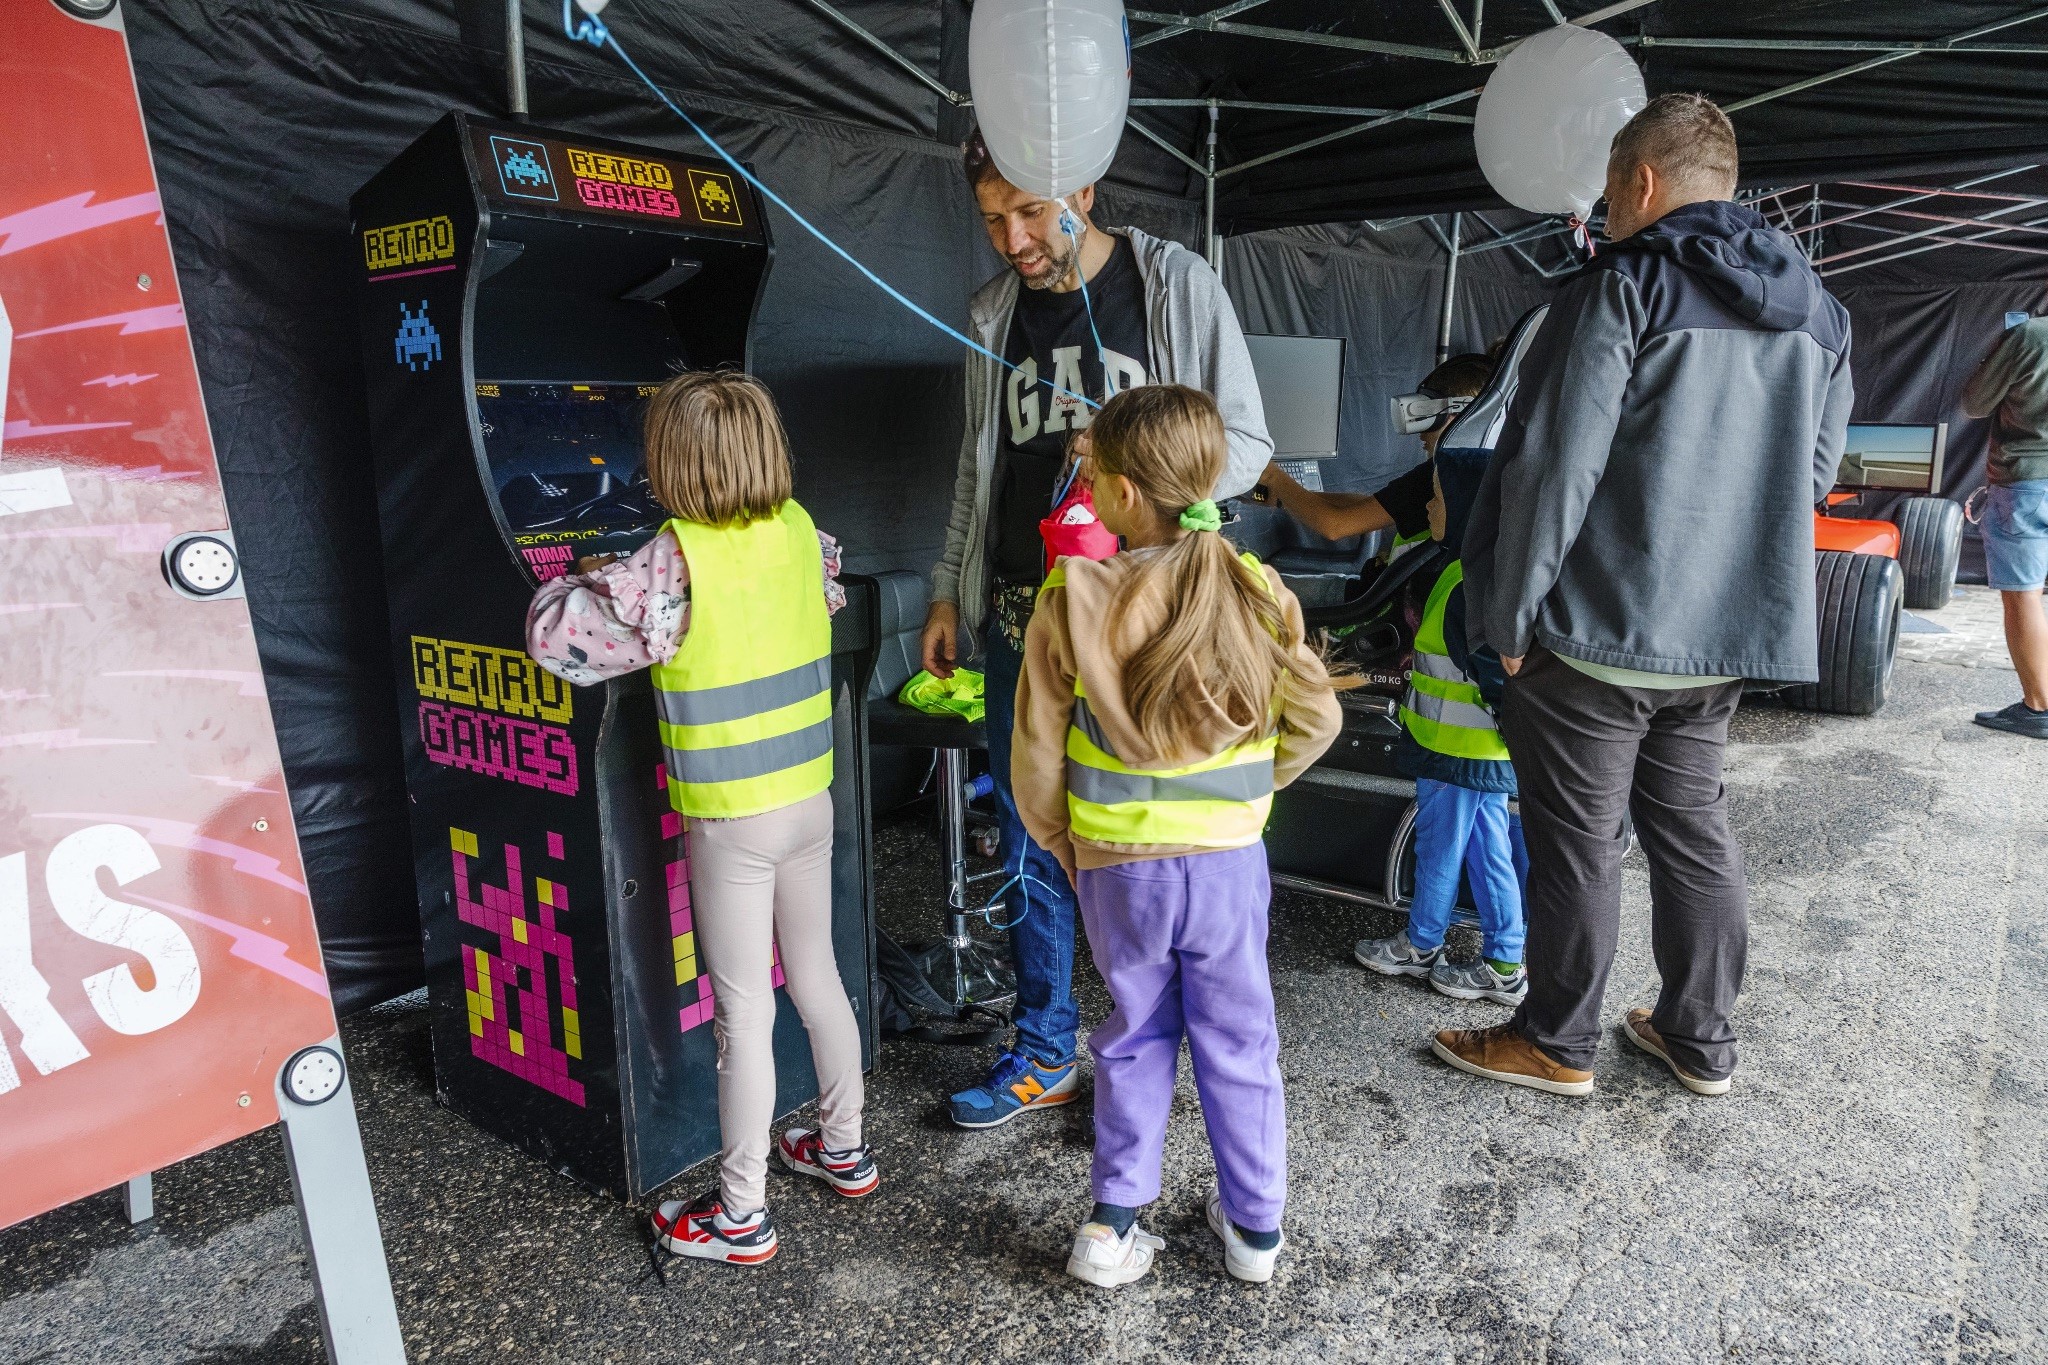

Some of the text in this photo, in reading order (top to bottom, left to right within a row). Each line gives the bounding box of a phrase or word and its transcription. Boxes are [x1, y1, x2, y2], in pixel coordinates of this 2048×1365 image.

[567, 149, 674, 190] RETRO
[576, 177, 681, 218] GAMES
[364, 215, 455, 270] RETRO
[1007, 345, 1147, 446] GAP
[1055, 395, 1082, 409] Origina
[410, 634, 574, 725] RETRO
[1373, 674, 1387, 684] 120
[1388, 676, 1401, 685] KG
[418, 700, 580, 797] GAMES
